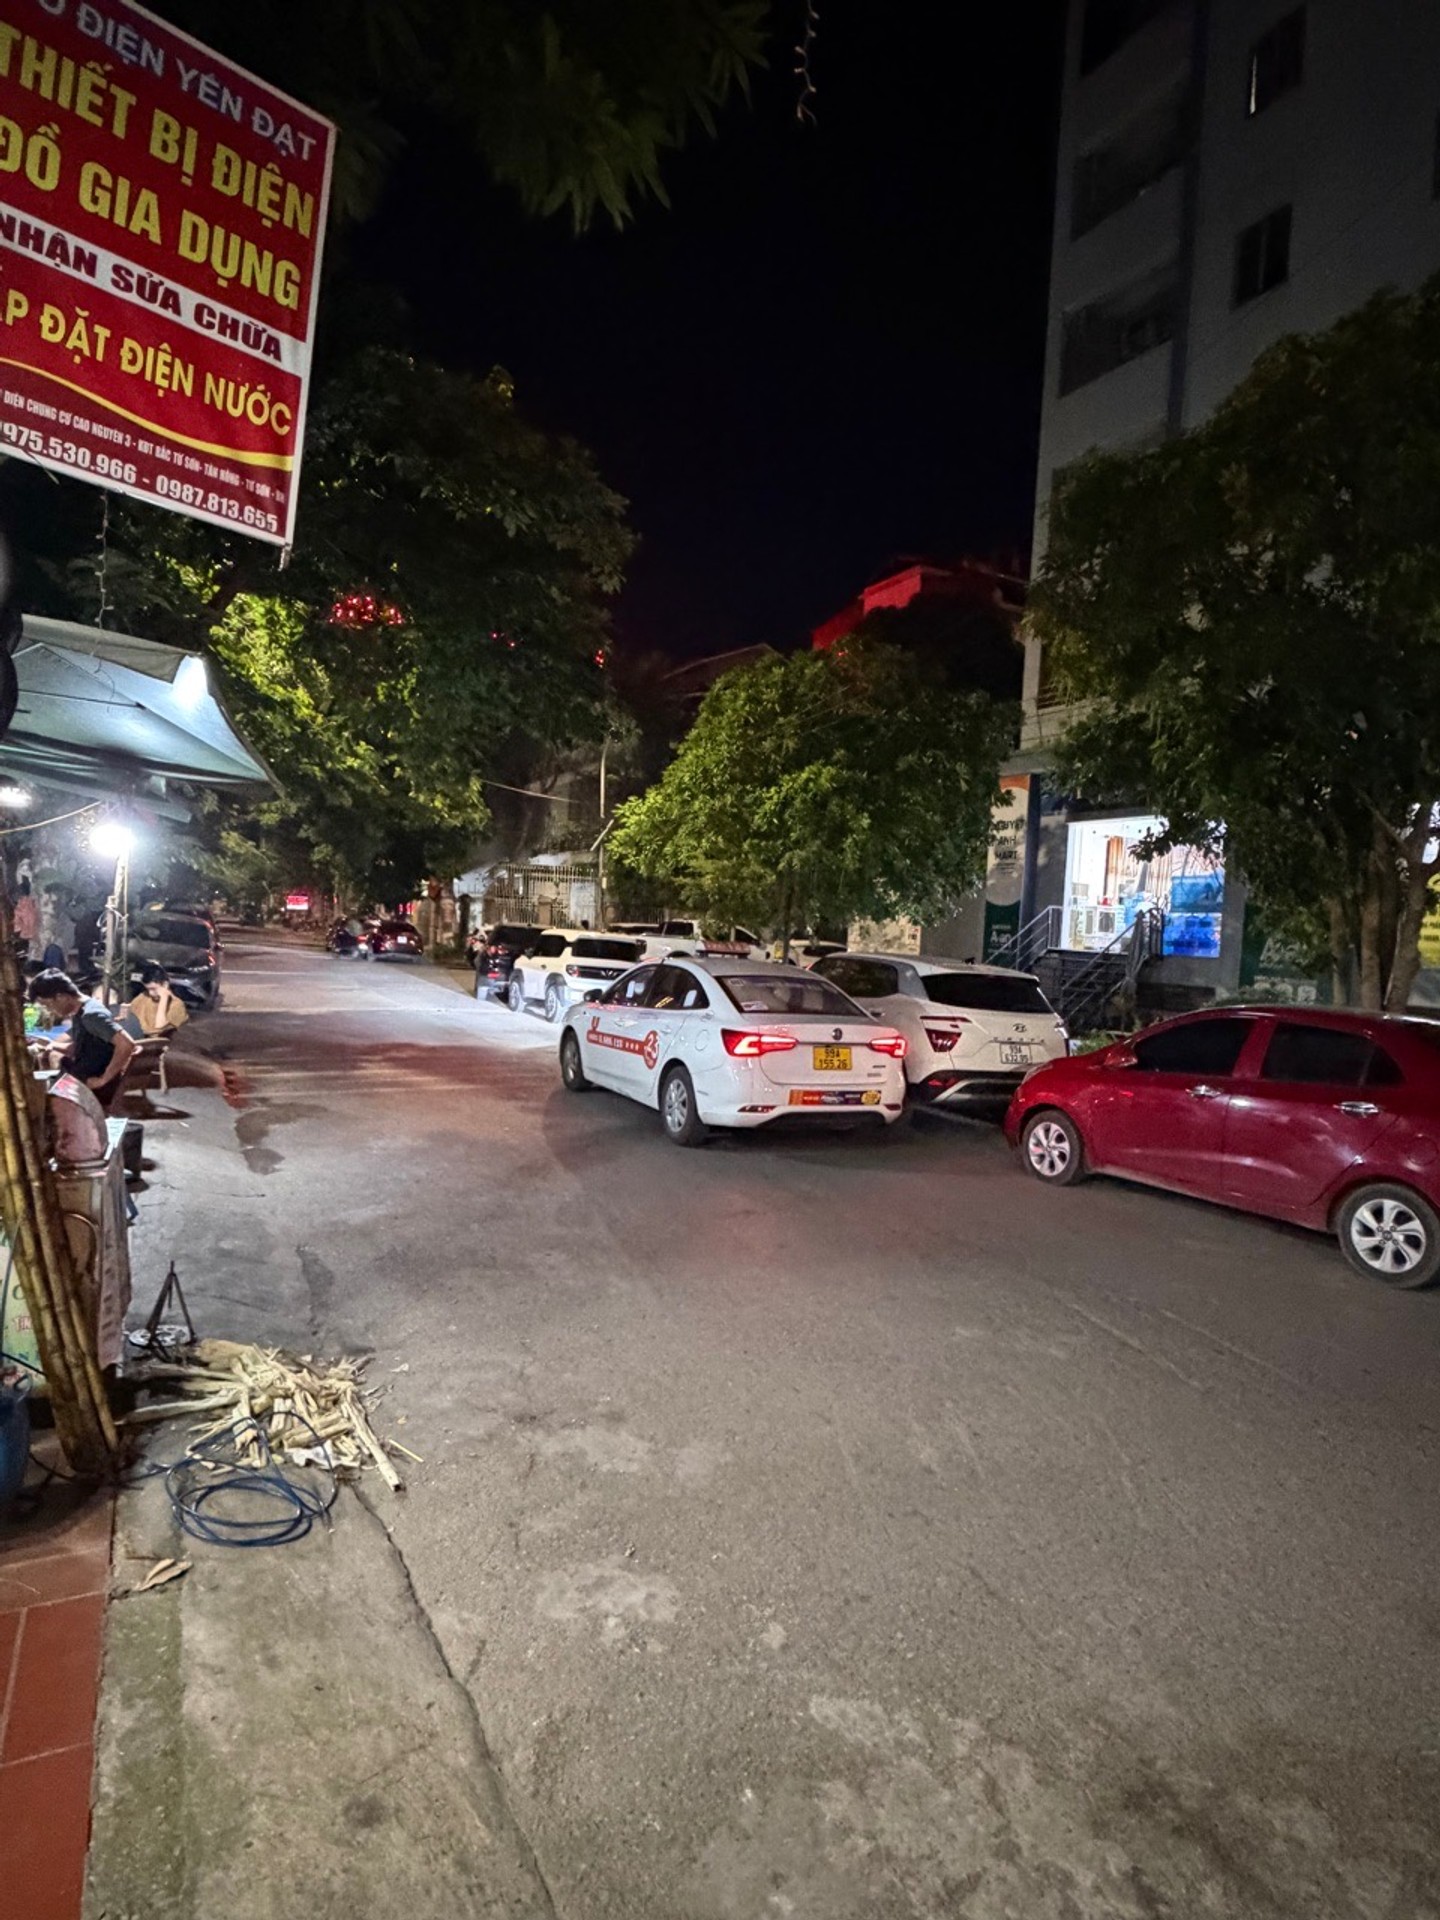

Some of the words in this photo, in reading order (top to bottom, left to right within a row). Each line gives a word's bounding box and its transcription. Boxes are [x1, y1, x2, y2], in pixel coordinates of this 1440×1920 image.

[0, 20, 137, 139] THIẾT
[150, 108, 198, 187] BỊ
[211, 142, 314, 239] ĐIỆN
[76, 3, 164, 77] ĐIỆN
[176, 58, 243, 122] YÊN
[252, 106, 316, 161] ĐẠT
[79, 161, 162, 245] GIA
[178, 208, 300, 310] DỤNG
[40, 302, 111, 364] ĐẶT
[120, 336, 194, 398] ĐIỆN
[204, 371, 292, 436] NƯỚC
[110, 263, 182, 317] SỬA
[193, 302, 282, 363] CHỮA
[0, 421, 137, 484] 975.530.966
[156, 475, 278, 532] 0987.813.655
[27, 399, 58, 421] CHUNG
